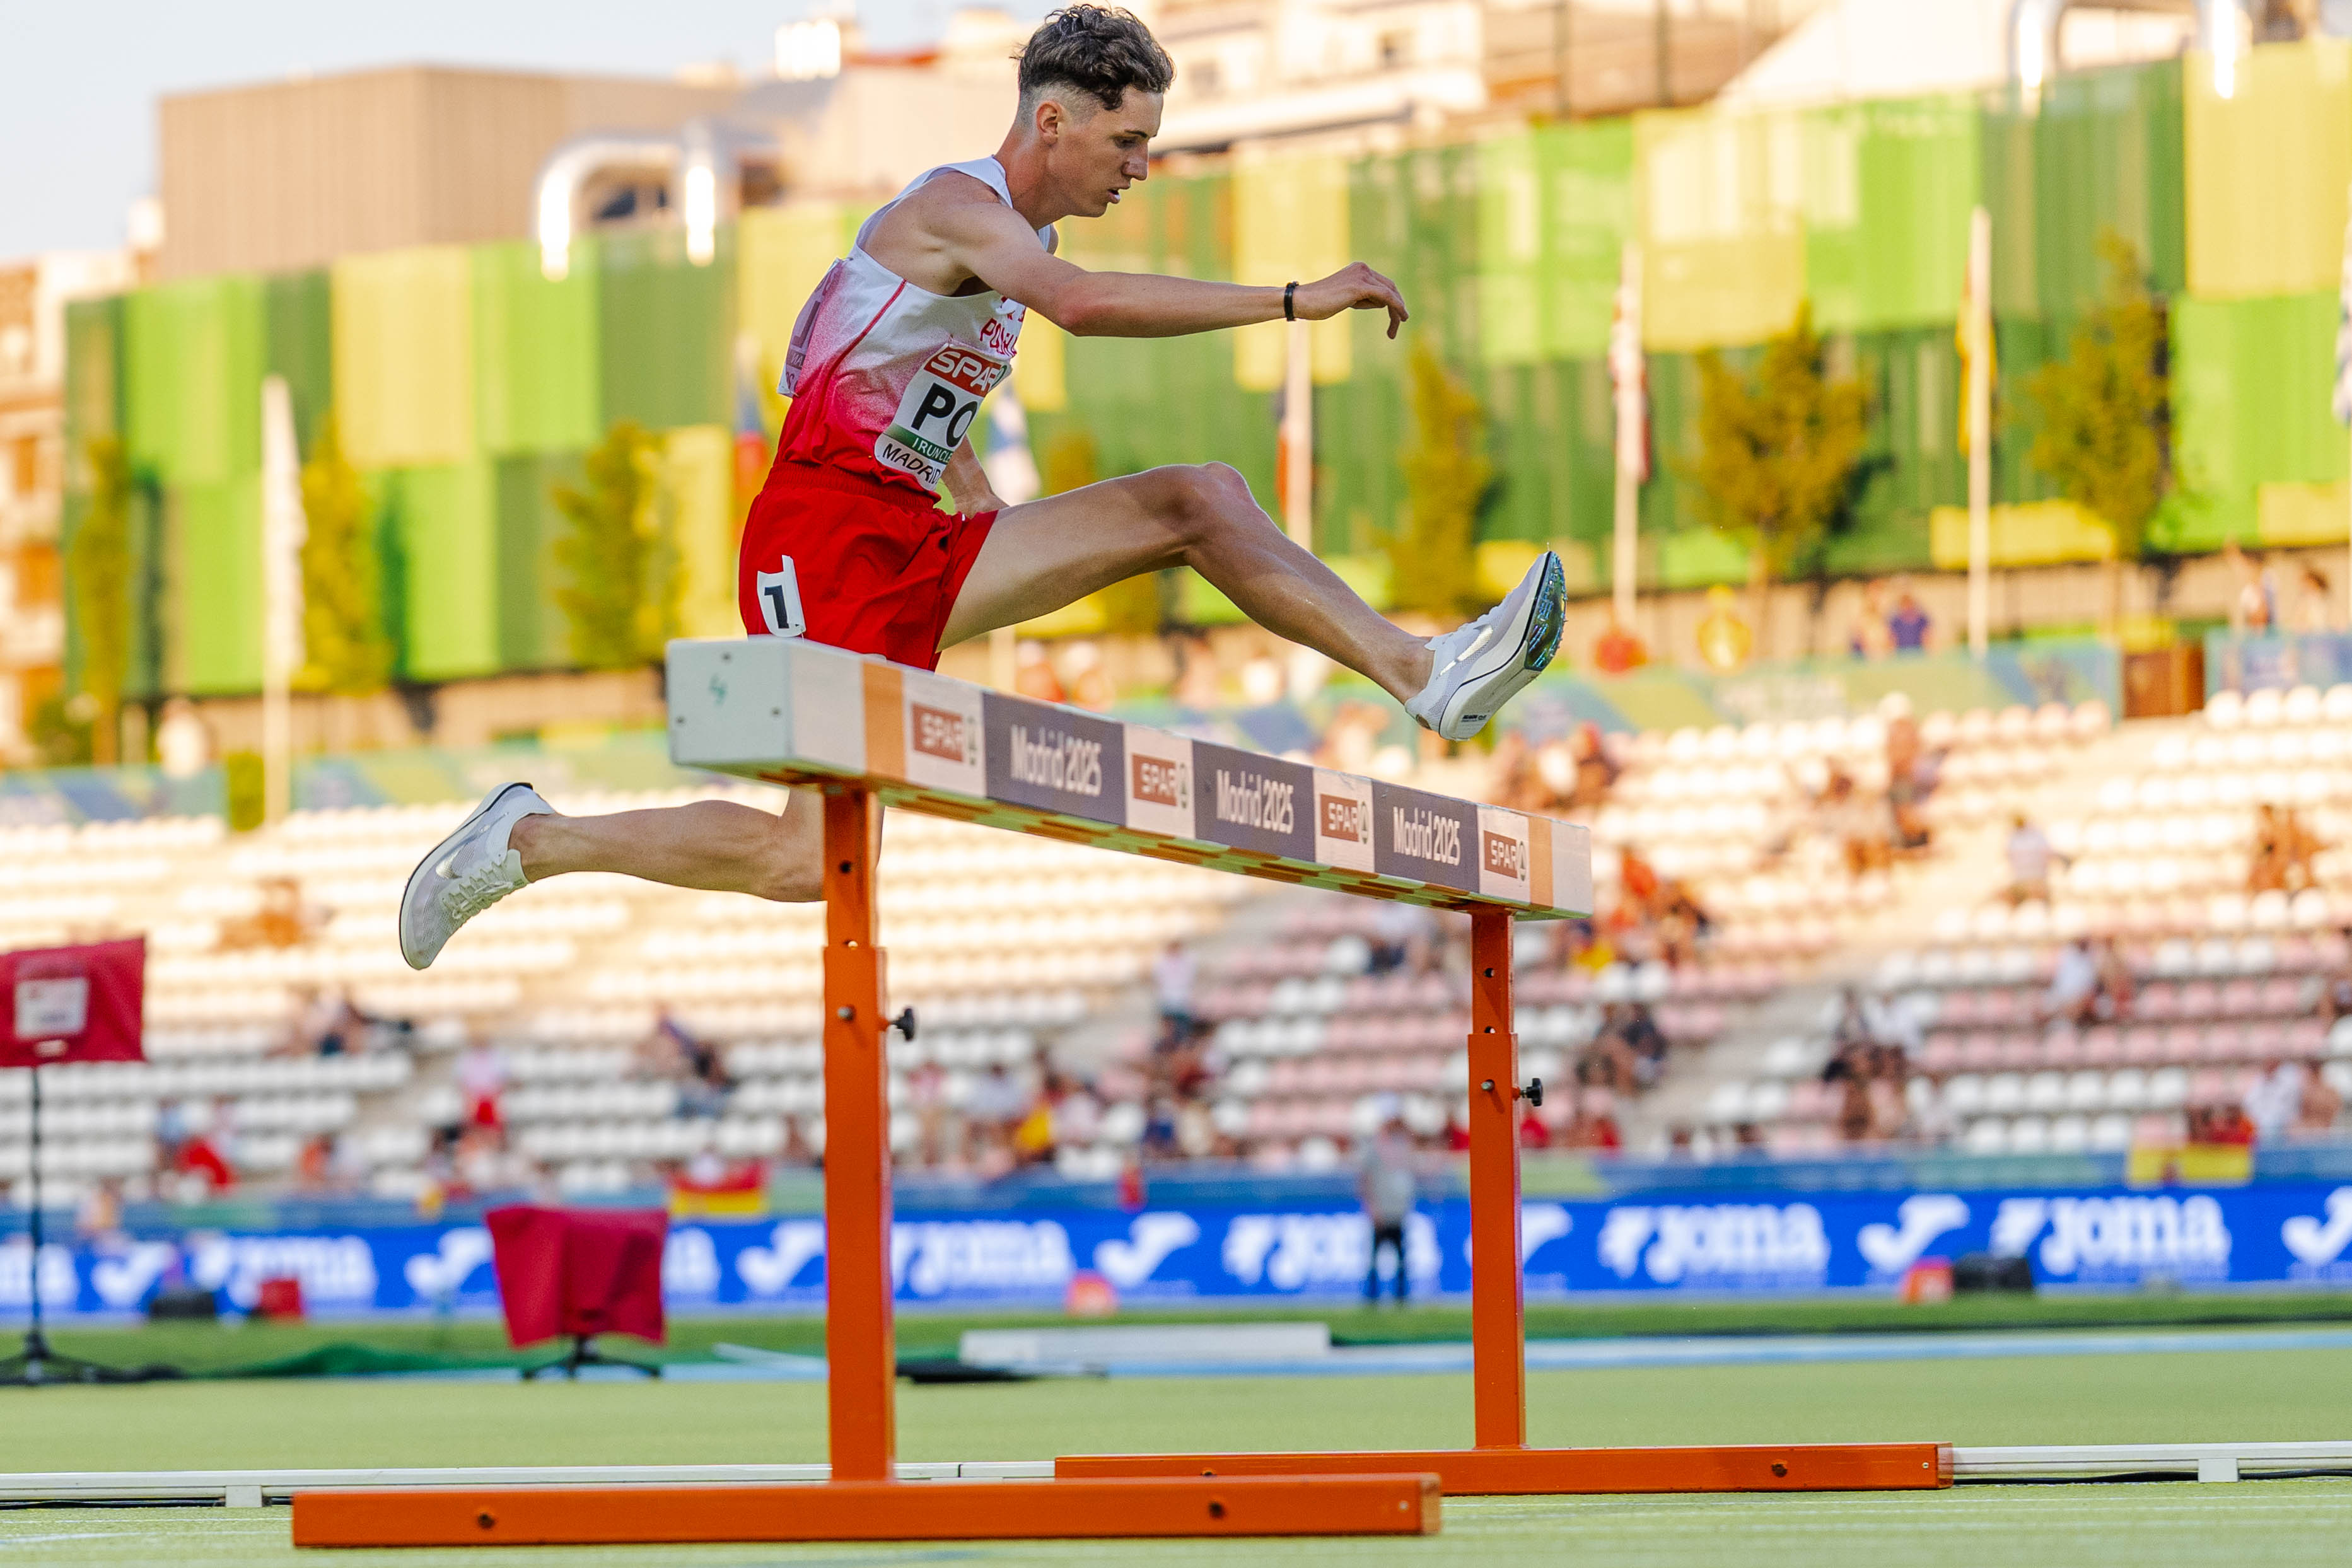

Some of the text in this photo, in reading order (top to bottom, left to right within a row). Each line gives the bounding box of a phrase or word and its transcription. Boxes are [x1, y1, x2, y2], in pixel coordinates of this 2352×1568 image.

[931, 351, 1000, 392] SPAR
[883, 443, 941, 485] MADRID
[764, 584, 789, 629] 1
[921, 711, 1518, 871] SPAR Madrid 2025 SPAR Madrid 2025 SPAR Madrid 2025 SPAR
